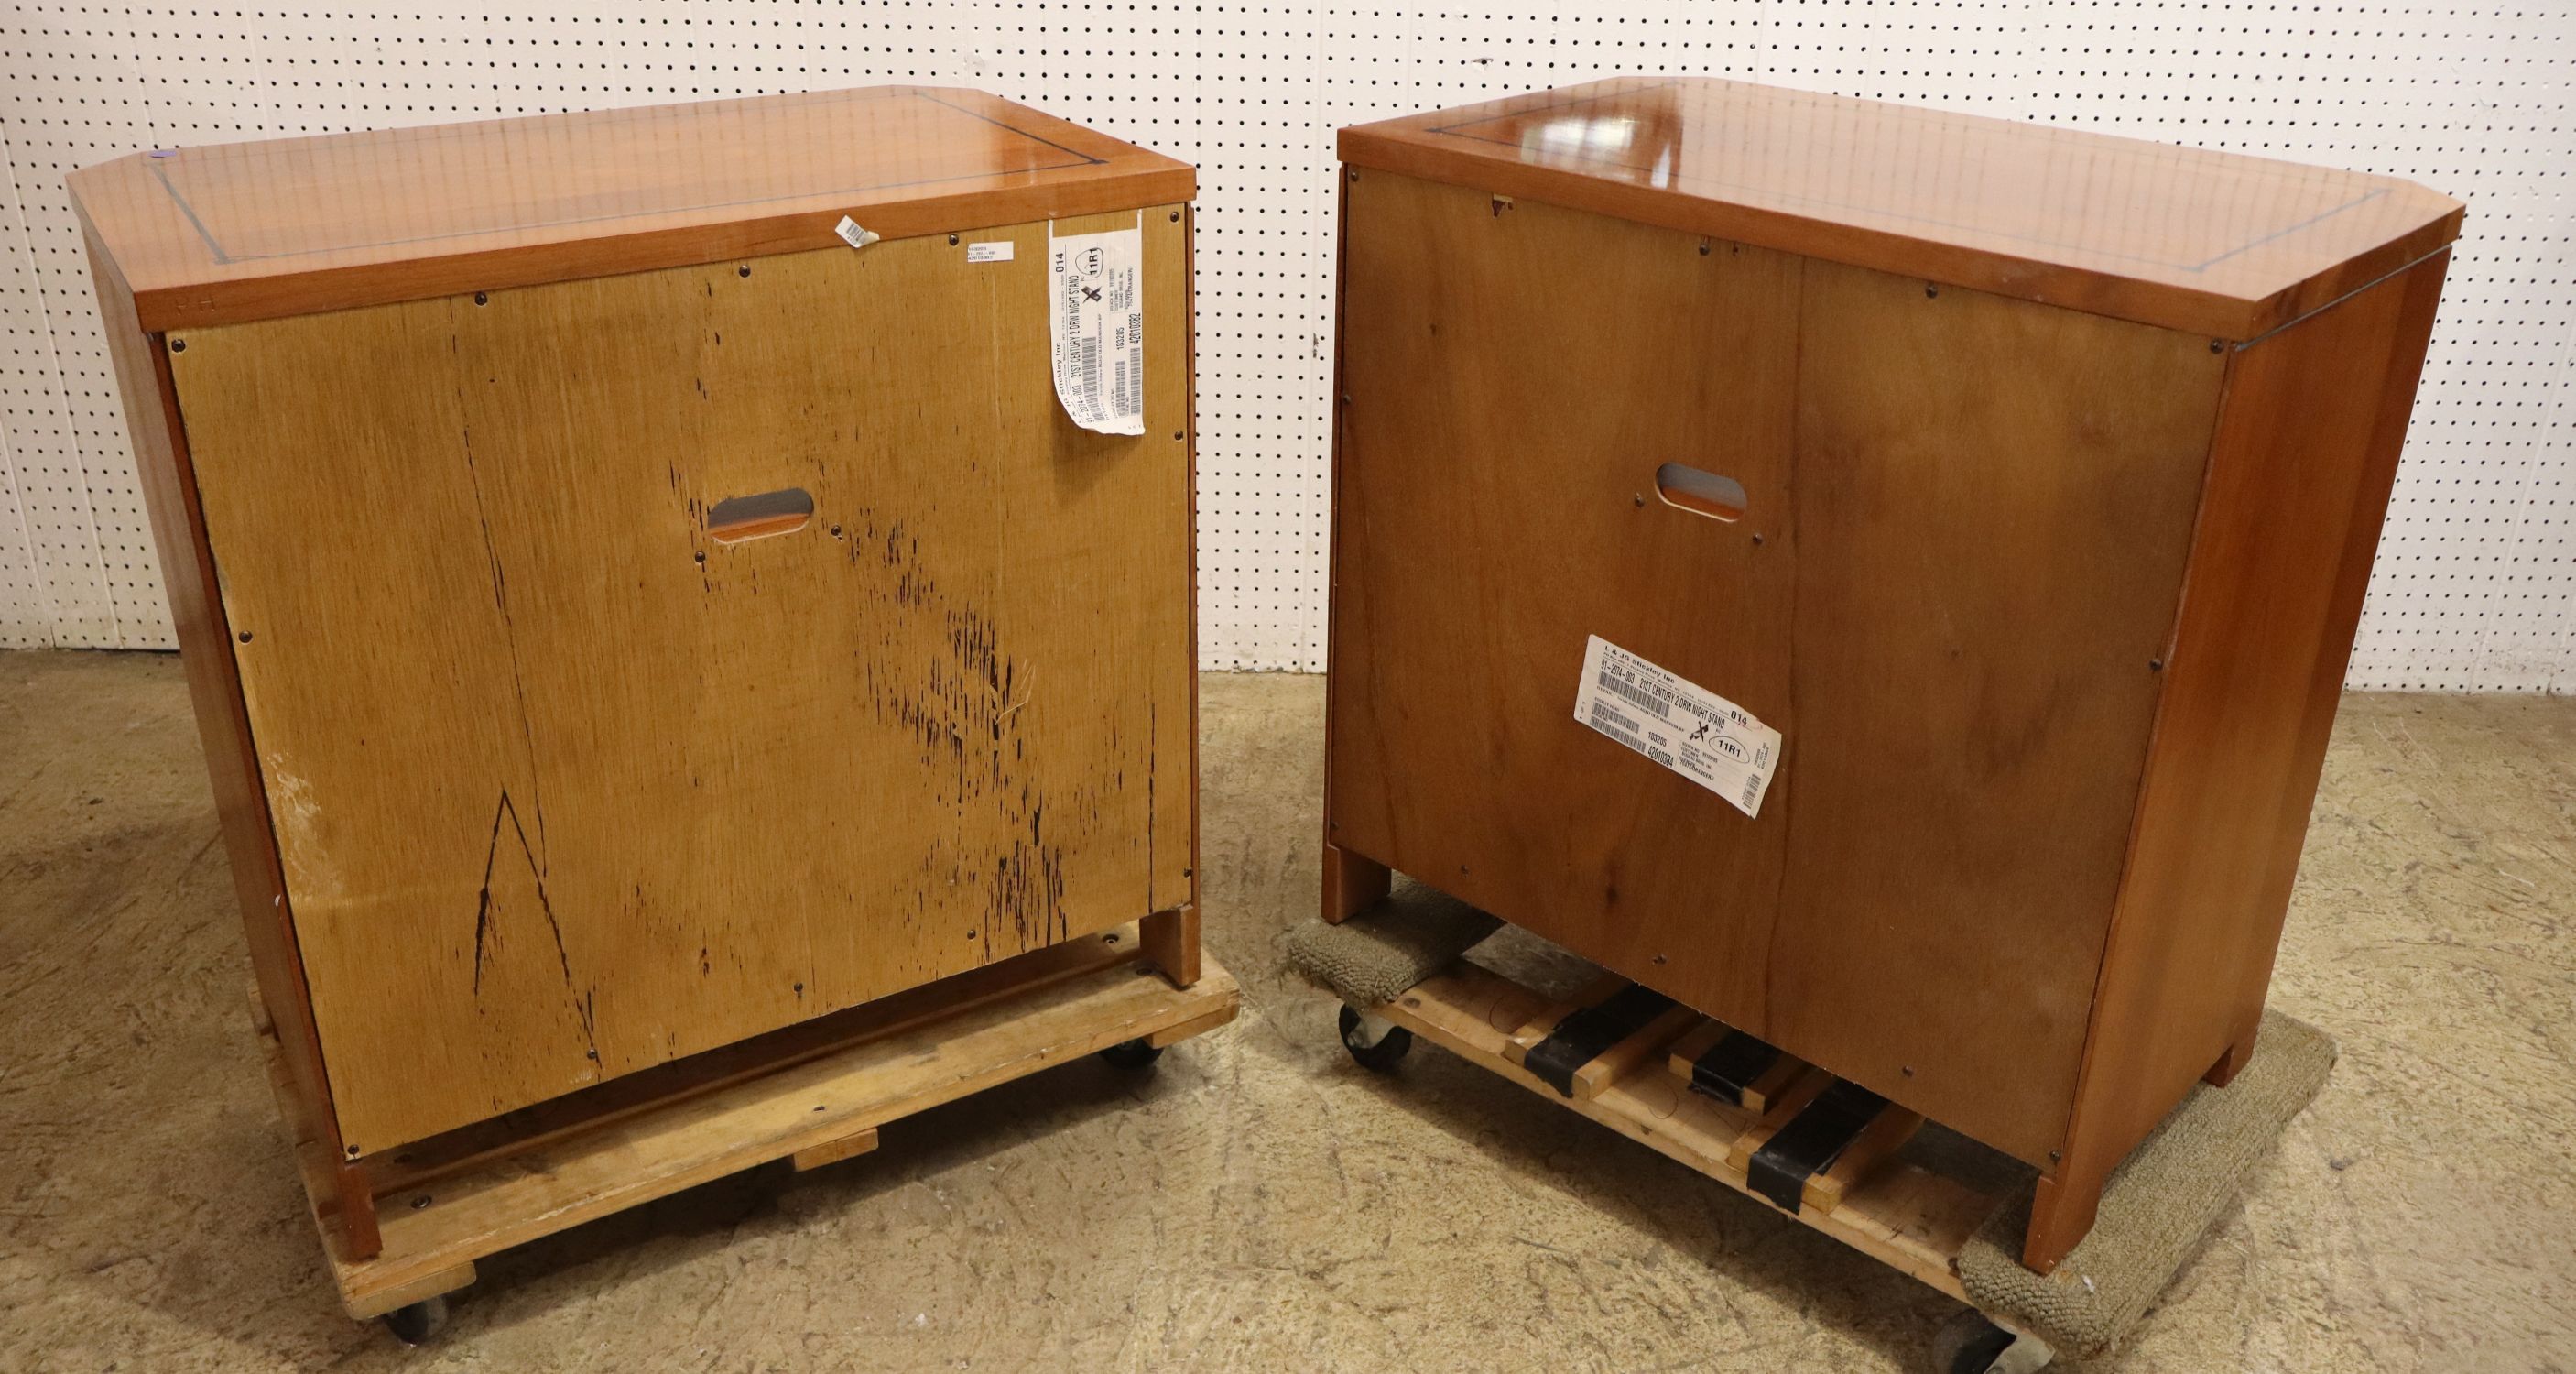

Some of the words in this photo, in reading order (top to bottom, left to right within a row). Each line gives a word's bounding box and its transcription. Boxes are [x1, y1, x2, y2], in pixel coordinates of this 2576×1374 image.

[1055, 253, 1064, 273] 014
[1089, 247, 1098, 275] 11R1
[1068, 275, 1079, 295] STAND
[1069, 296, 1080, 313] NIGHT
[1070, 316, 1080, 330] DRW
[1115, 327, 1125, 350] 183205
[1070, 337, 1081, 363] CENTURY
[1057, 359, 1065, 395] Stickley
[1070, 365, 1081, 377] 21ST
[1632, 659, 1661, 678] Stickley
[1663, 674, 1675, 683] Inc
[1639, 678, 1652, 692] 21ST
[1652, 682, 1676, 703] CENTURY
[1674, 696, 1679, 706] 2
[1679, 698, 1691, 713] DRW
[1692, 703, 1709, 720] NIGHT
[1708, 712, 1725, 729] STAND
[1731, 710, 1747, 725] 014
[1648, 731, 1667, 747] 183205
[1718, 740, 1741, 758] 11R1
